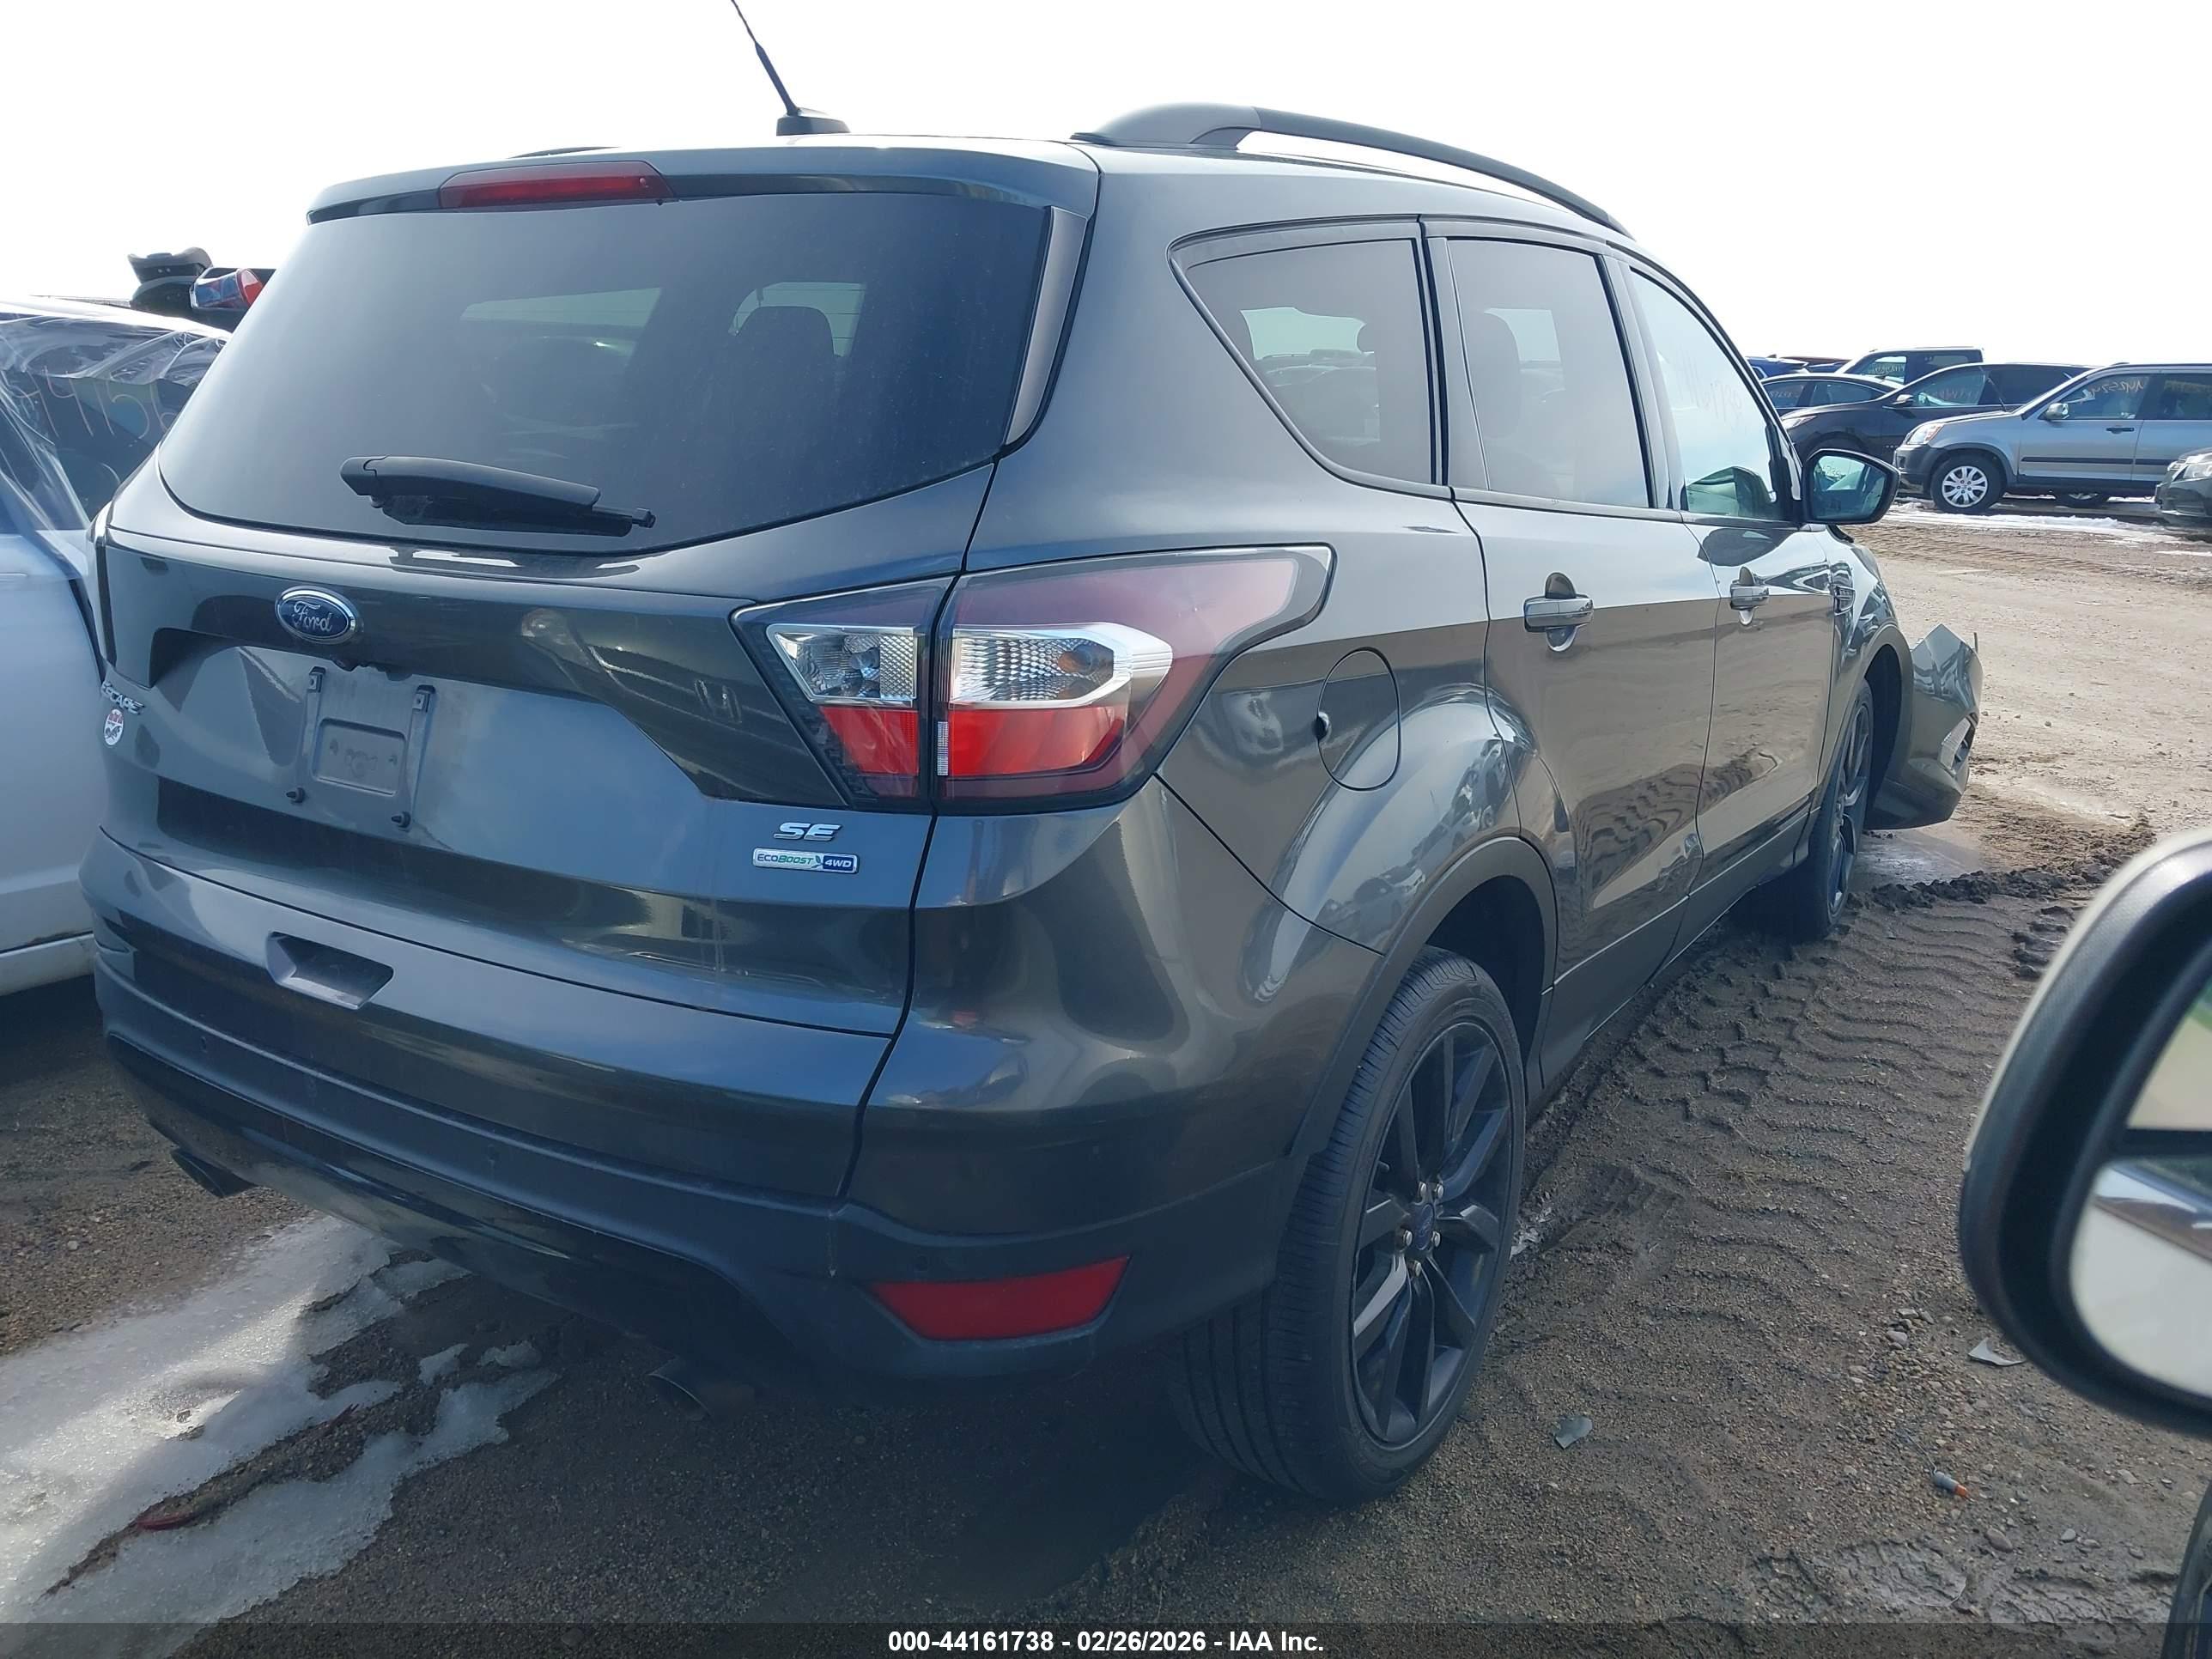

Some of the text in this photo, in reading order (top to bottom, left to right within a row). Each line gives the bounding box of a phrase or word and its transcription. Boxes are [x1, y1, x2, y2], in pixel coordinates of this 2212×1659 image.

[292, 600, 333, 632] Ford
[774, 822, 842, 842] SE
[824, 859, 853, 868] 4WD
